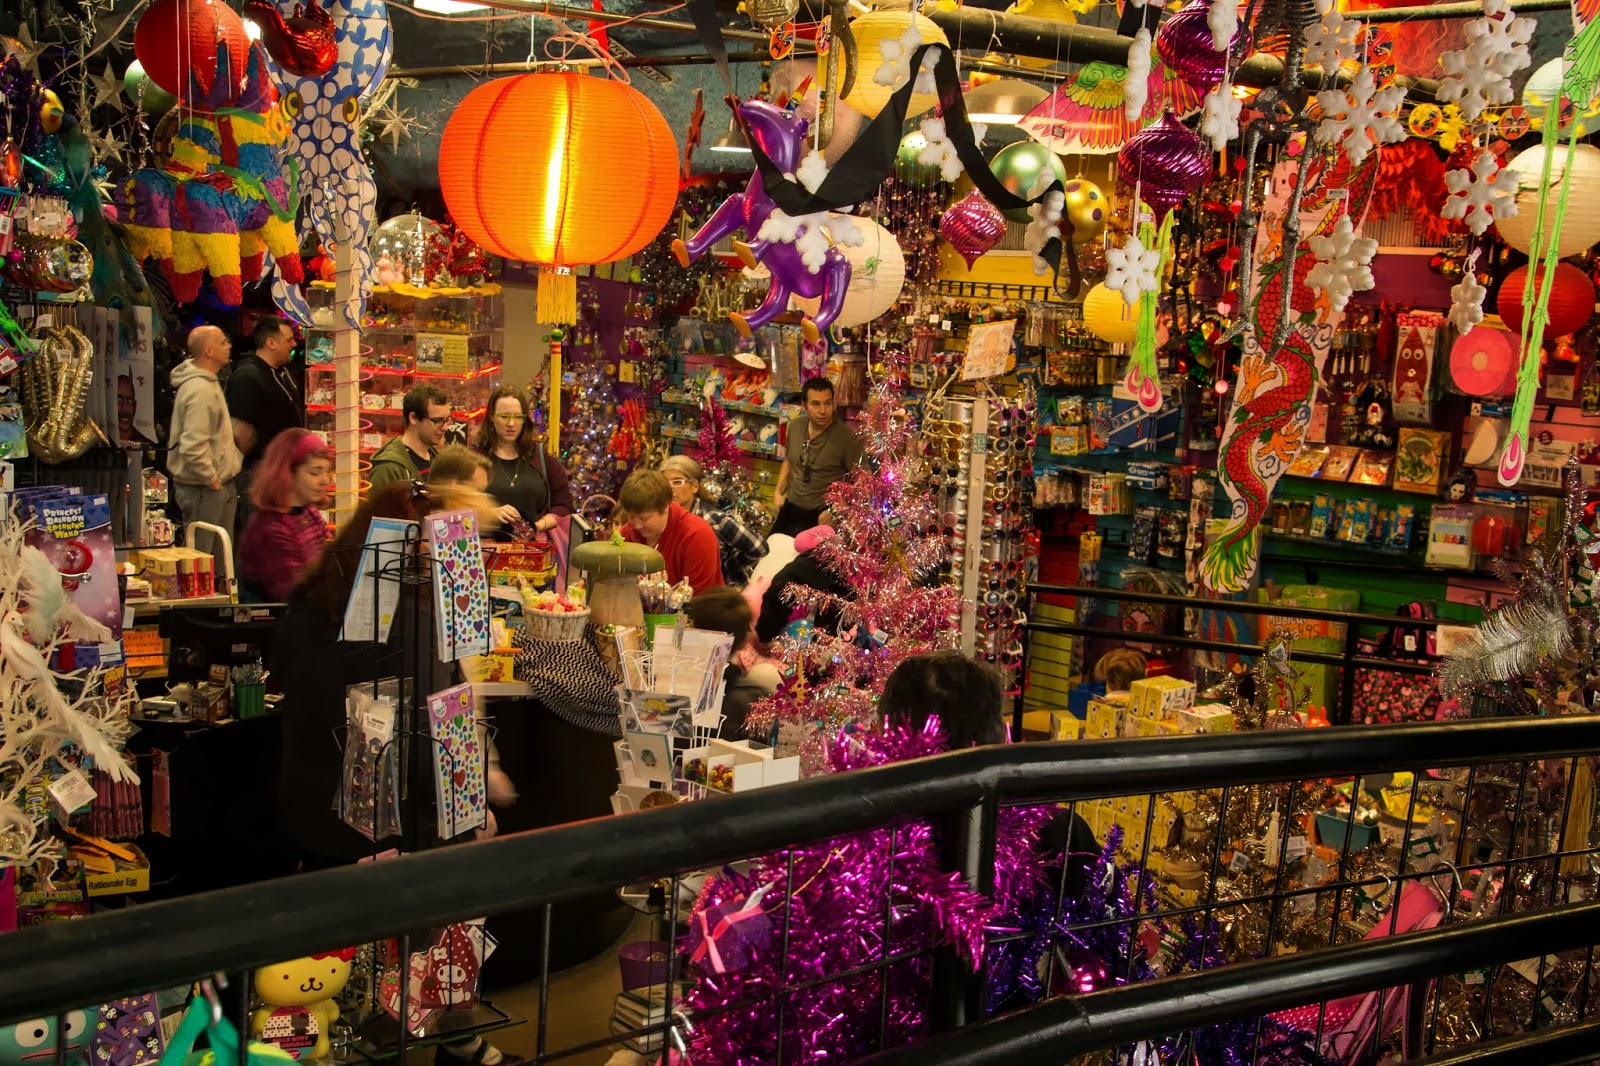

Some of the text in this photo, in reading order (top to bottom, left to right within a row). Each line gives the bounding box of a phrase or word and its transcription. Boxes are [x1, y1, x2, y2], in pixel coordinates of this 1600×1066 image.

[43, 507, 82, 517] PRINCESS
[46, 515, 85, 525] RAINBOW
[46, 522, 85, 534] SPINNING
[54, 530, 80, 539] WAND
[104, 665, 125, 685] GROW
[89, 879, 124, 889] Rattlesnake
[126, 877, 138, 887] Egg
